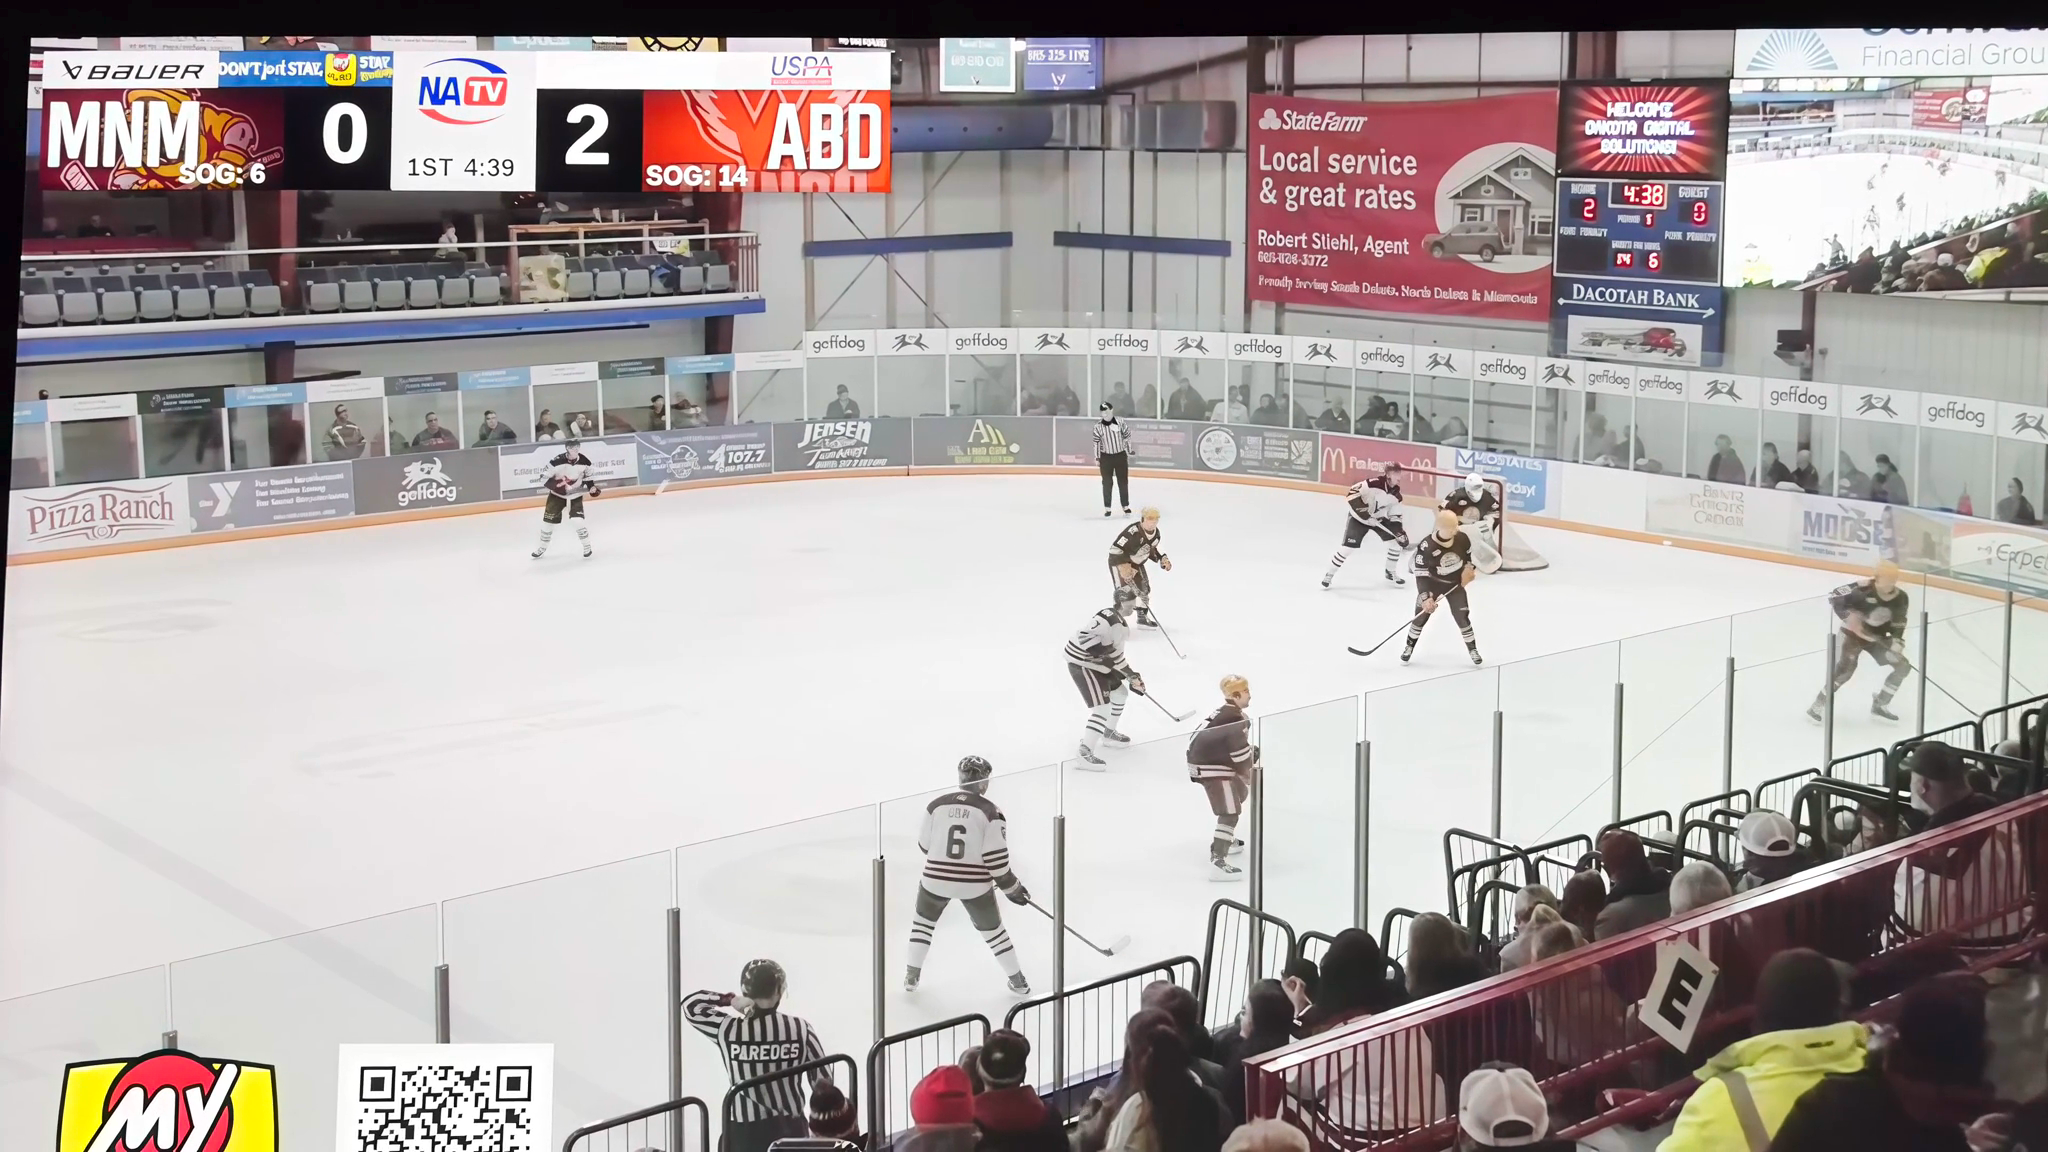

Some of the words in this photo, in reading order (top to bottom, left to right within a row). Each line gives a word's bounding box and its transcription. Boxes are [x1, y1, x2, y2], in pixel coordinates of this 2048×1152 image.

[771, 56, 833, 76] USPA
[1862, 43, 1972, 67] Financial
[47, 101, 200, 169] MNM
[322, 101, 369, 165] 0
[564, 103, 610, 166] 2
[766, 102, 882, 171] ABD
[408, 158, 453, 177] 1ST
[464, 158, 514, 177] 4:39
[1259, 144, 1320, 173] Local
[1327, 148, 1418, 175] service
[179, 163, 244, 185] SOG:
[250, 163, 266, 185] 6
[645, 165, 711, 187] SOG:
[718, 165, 749, 187] 14
[1259, 176, 1278, 205] &
[1285, 182, 1345, 212] great
[1355, 184, 1417, 210] rates
[1623, 184, 1664, 206] 4:38
[1583, 198, 1595, 218] 2
[1258, 229, 1308, 249] Robert
[1312, 232, 1359, 255] Stiehl,
[1363, 235, 1410, 257] Agent
[1648, 252, 1659, 269] 6
[1572, 283, 1649, 305] DACOTAH
[1653, 289, 1701, 309] BANK
[797, 421, 872, 449] JENSEN
[727, 450, 766, 464] 107.7
[26, 502, 96, 535] Pizza
[98, 491, 174, 523] Ranch
[945, 824, 967, 860] 6
[1657, 957, 1703, 1031] E
[731, 1043, 800, 1061] PAREDES
